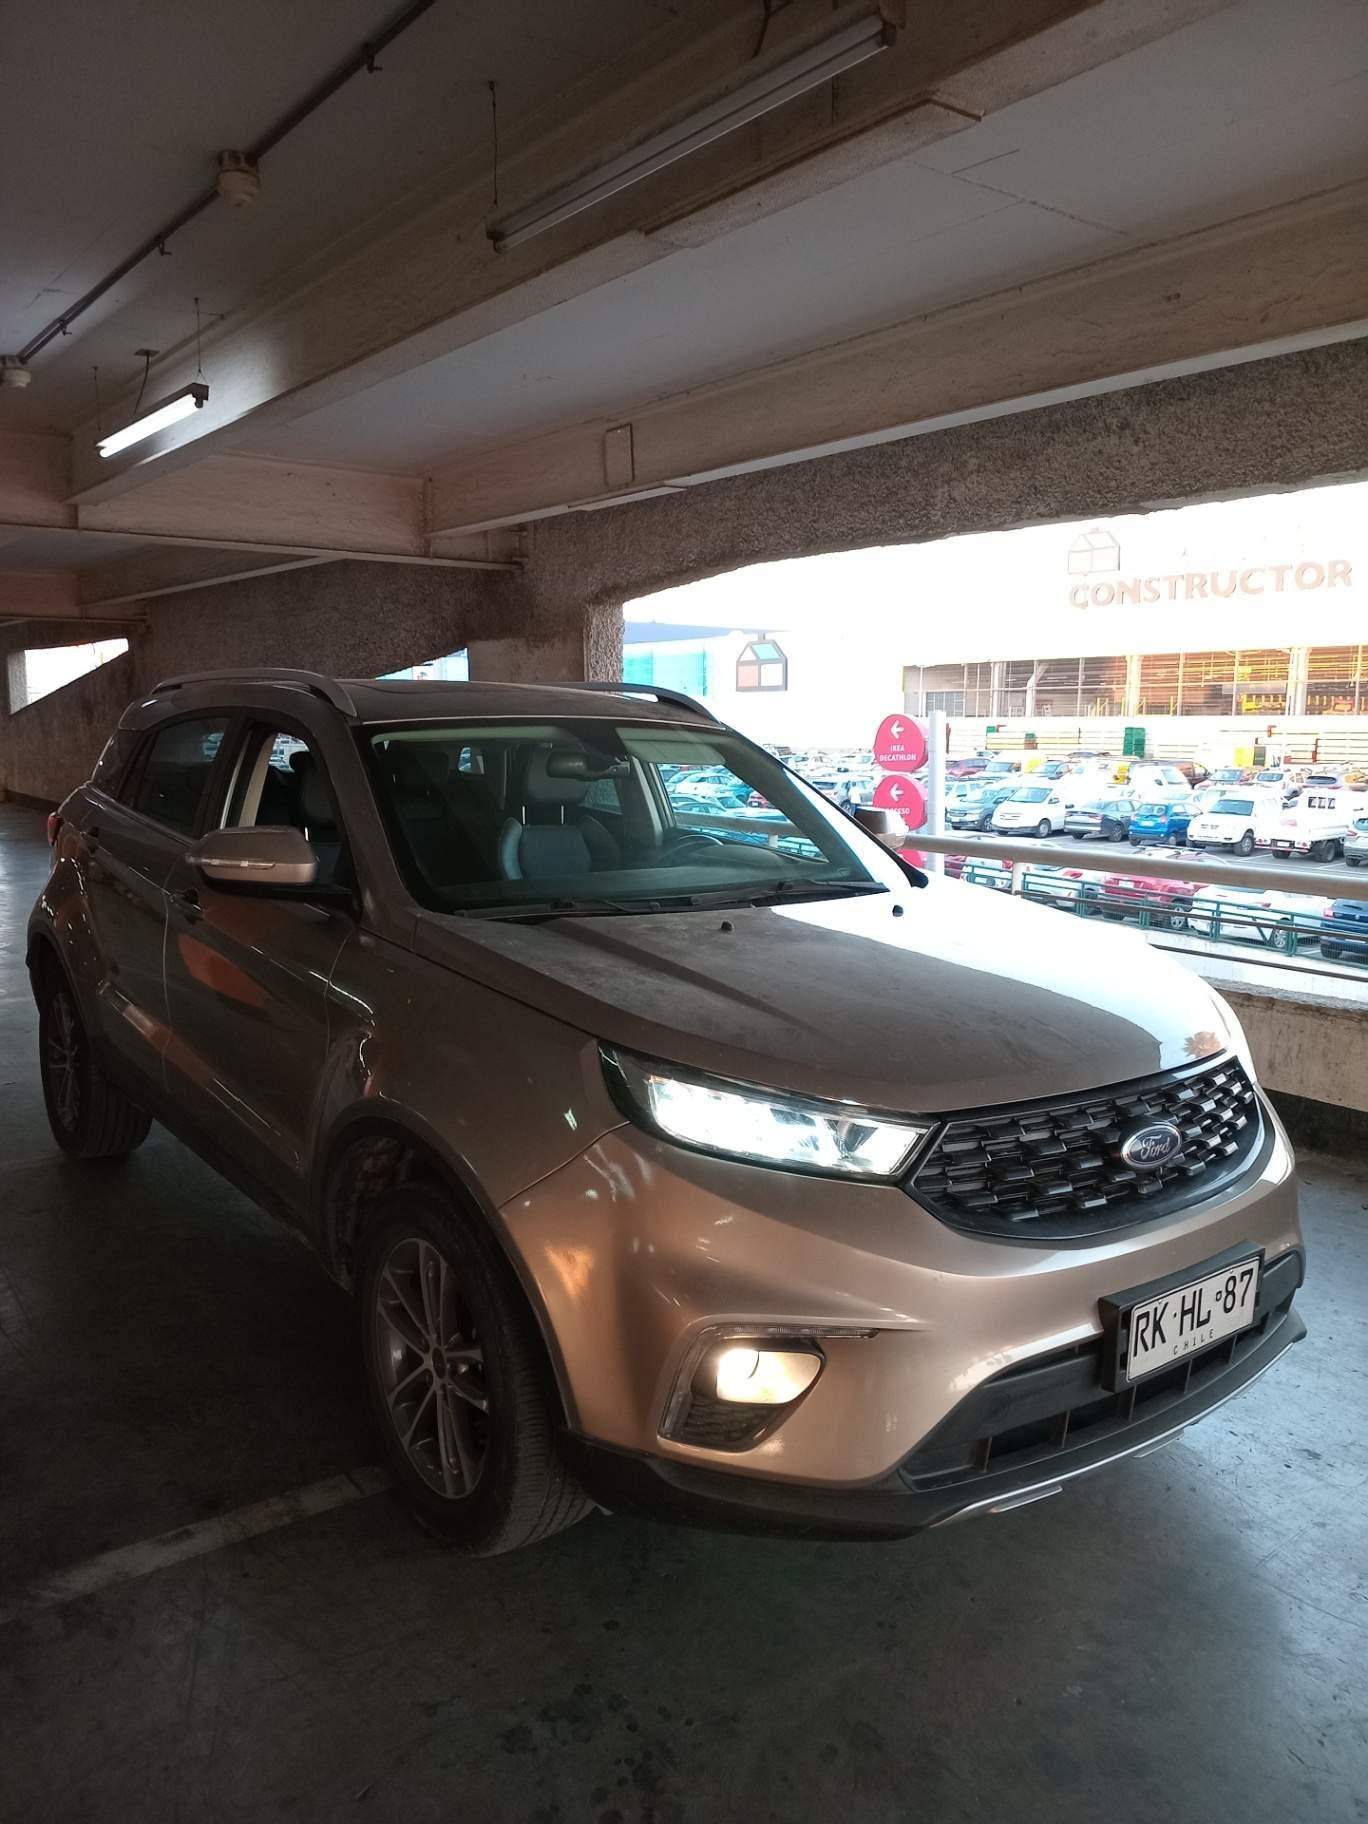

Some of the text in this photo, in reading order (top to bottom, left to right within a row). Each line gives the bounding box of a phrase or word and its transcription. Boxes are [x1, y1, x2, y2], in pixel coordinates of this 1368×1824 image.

[1070, 559, 1352, 609] CONSTRUCTOR
[1140, 1134, 1170, 1159] Ford
[1173, 1329, 1215, 1355] CHILE
